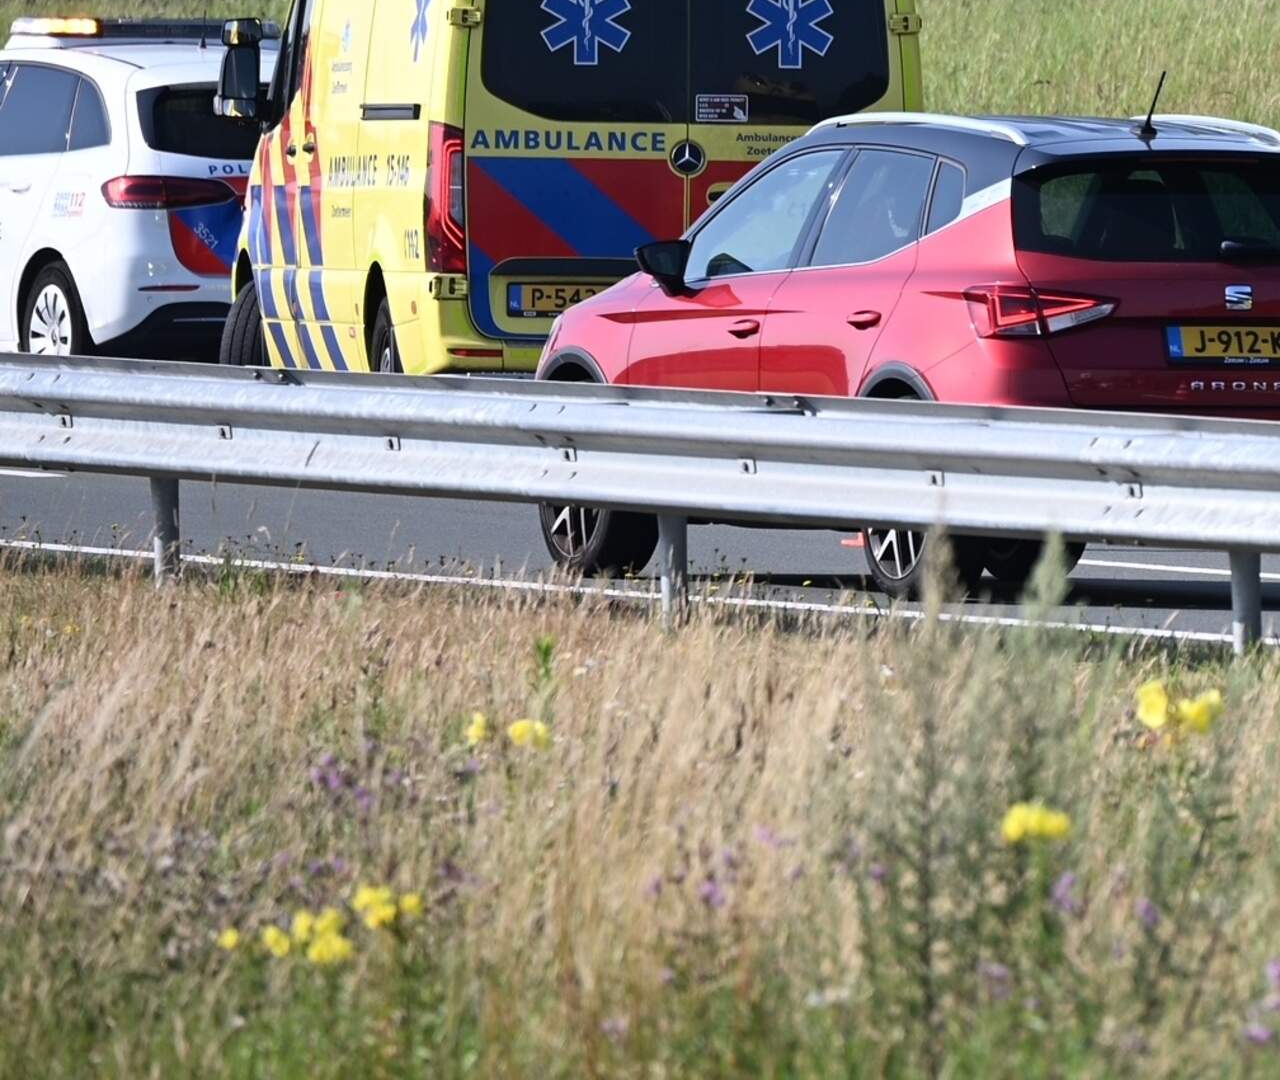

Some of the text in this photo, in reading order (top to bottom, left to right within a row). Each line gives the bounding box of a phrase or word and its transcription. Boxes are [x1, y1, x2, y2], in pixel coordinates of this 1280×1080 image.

[471, 130, 666, 153] AMBULANCE
[736, 133, 801, 143] Ambulance
[208, 165, 248, 175] POL
[328, 155, 410, 187] AMBULANCE 15-146
[193, 222, 219, 250] 3521
